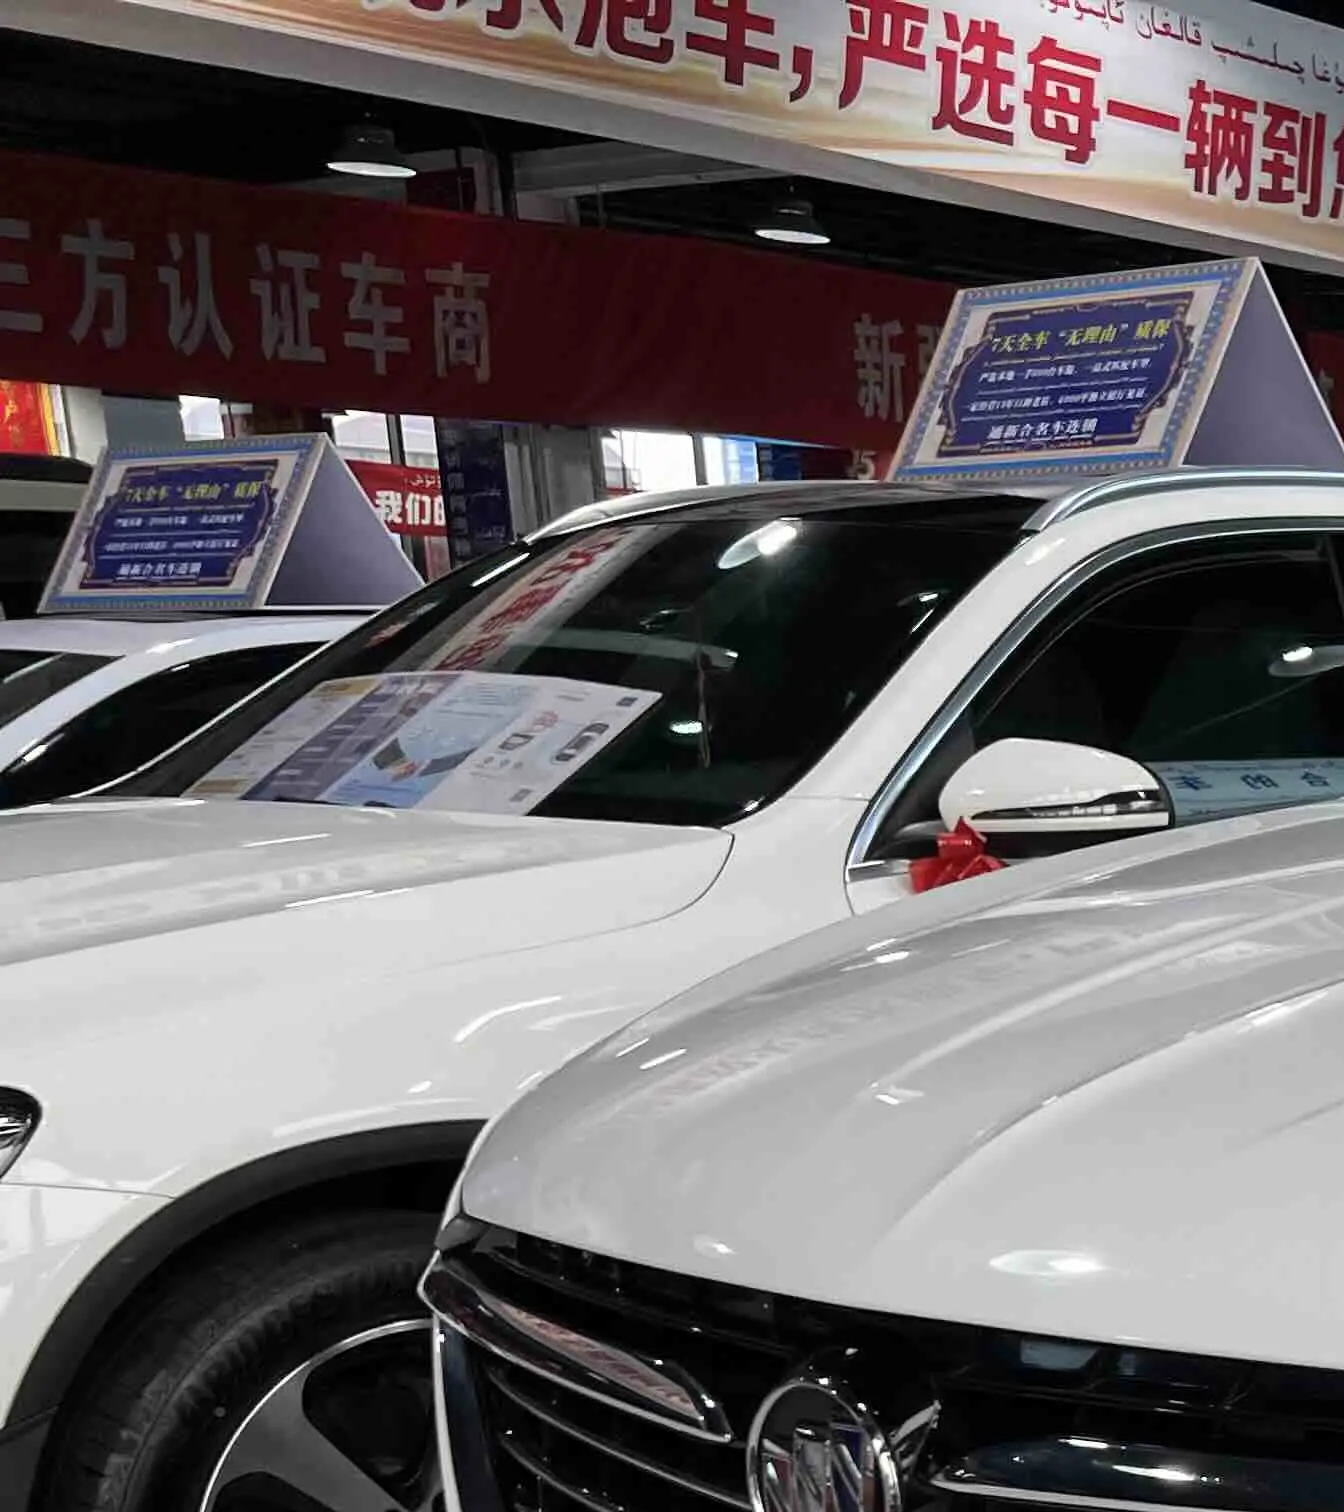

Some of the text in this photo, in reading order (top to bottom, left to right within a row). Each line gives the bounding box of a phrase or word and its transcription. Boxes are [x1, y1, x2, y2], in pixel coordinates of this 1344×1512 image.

[0, 217, 491, 384] 三方认证车商
